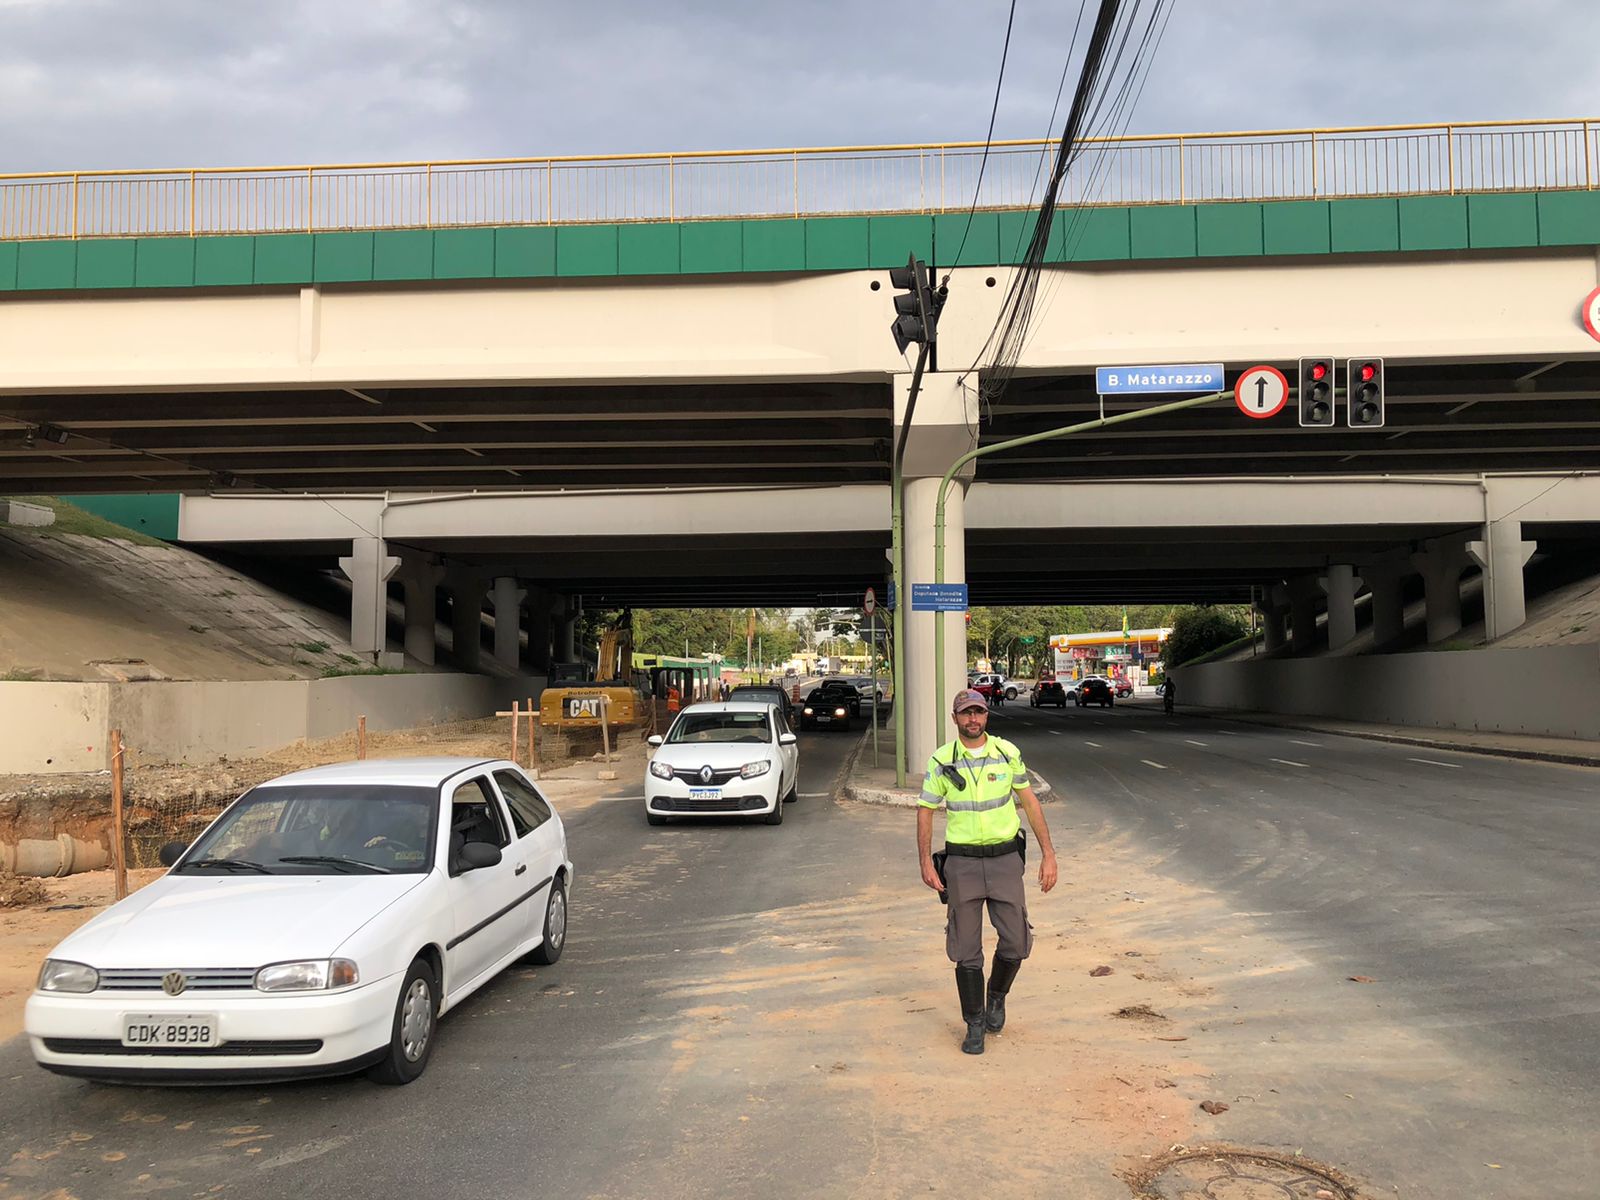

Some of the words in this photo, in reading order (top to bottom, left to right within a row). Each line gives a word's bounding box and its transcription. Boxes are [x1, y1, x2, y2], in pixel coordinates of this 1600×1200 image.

[1108, 374, 1123, 387] B.
[1128, 373, 1212, 386] Matarazzo
[570, 699, 599, 718] CAT
